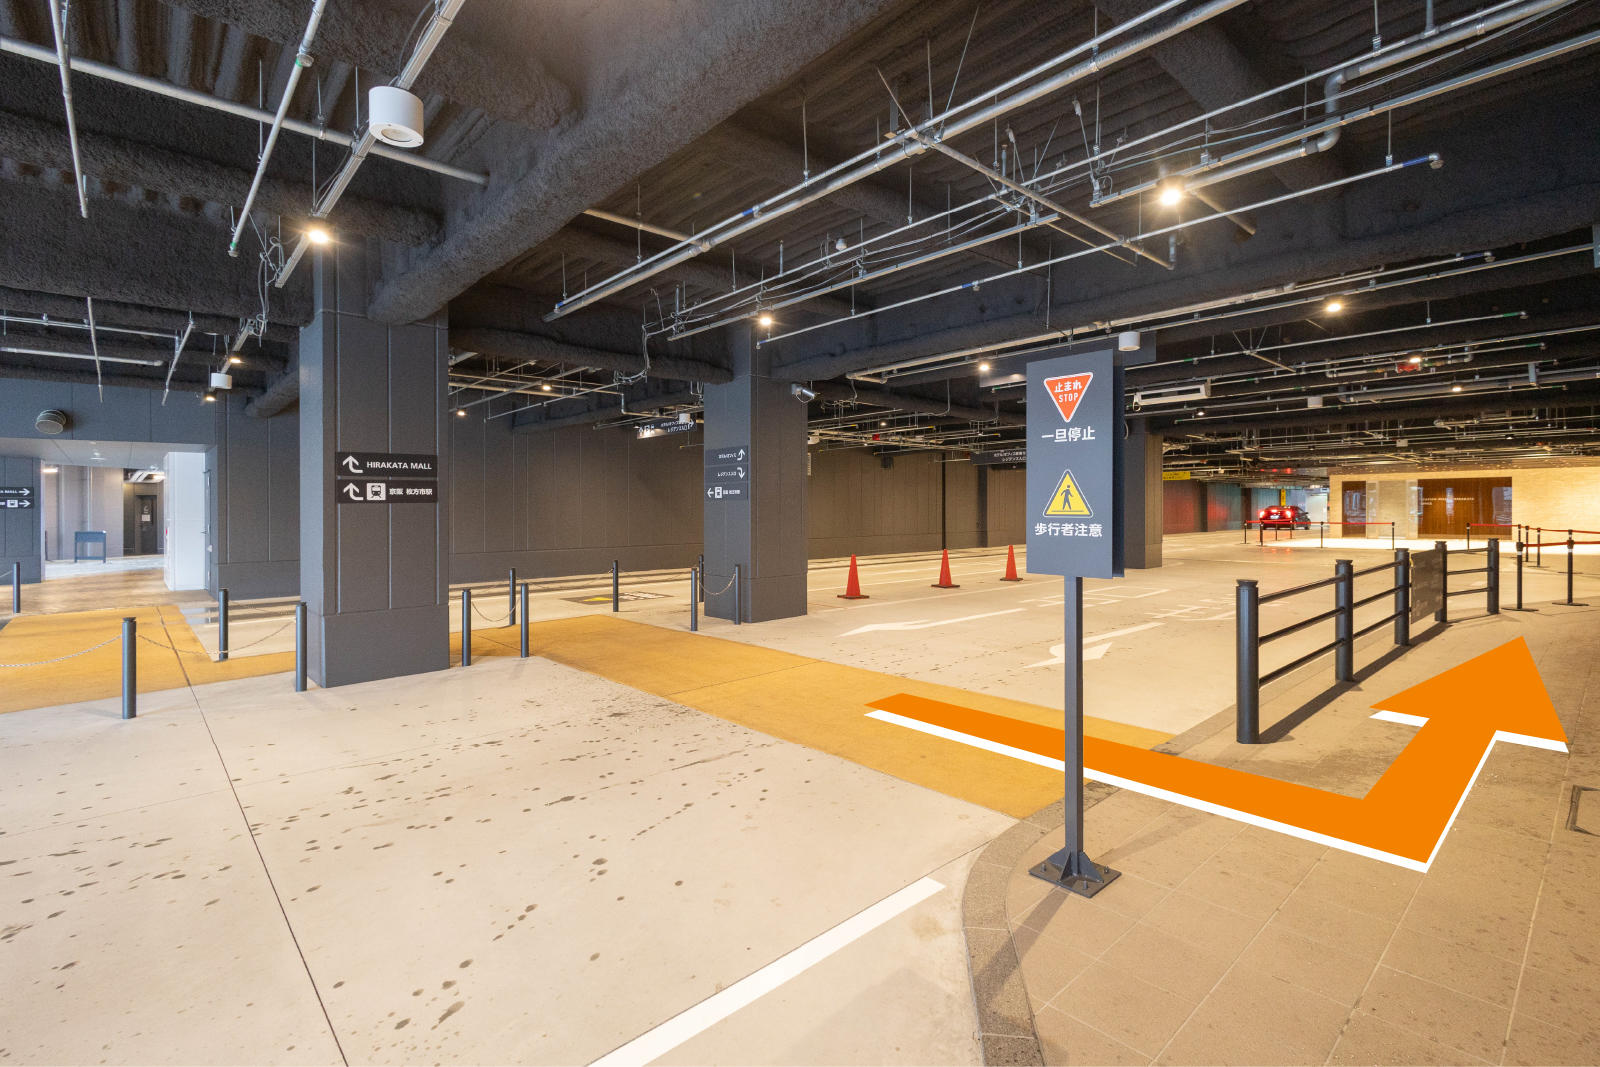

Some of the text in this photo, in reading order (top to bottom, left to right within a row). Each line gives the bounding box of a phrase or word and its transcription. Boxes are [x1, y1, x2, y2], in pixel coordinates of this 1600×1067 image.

[1054, 380, 1082, 393] 止まれ
[1058, 393, 1079, 403] STOP
[1041, 426, 1095, 442] 一旦停止
[366, 461, 408, 469] HIRAKATA
[1034, 523, 1103, 537] 歩行者注意
